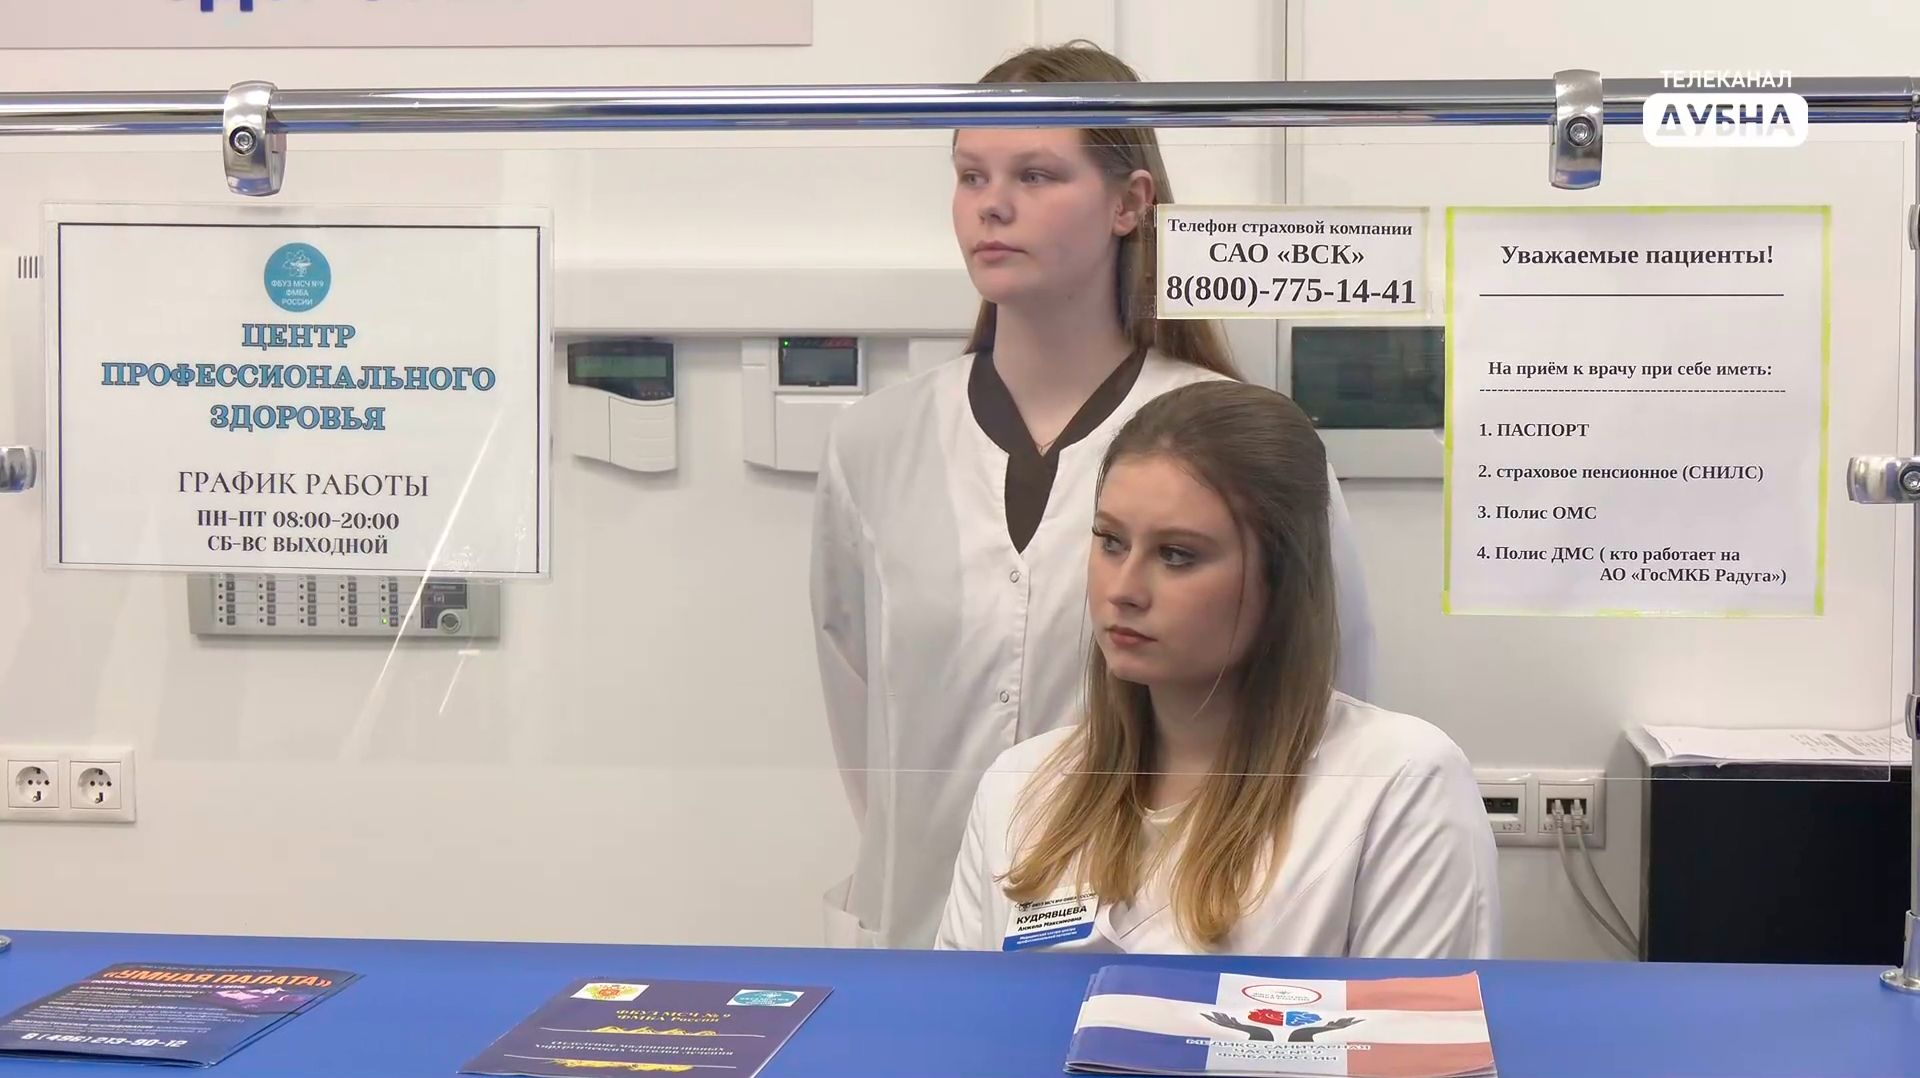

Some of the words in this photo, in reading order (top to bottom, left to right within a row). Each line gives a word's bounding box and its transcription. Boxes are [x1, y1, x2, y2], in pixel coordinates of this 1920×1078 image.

[1167, 218, 1237, 236] Телефон
[1241, 220, 1325, 237] страховой
[1329, 223, 1413, 236] компании
[1209, 242, 1269, 264] САО
[1277, 243, 1365, 265] «ВСК»
[1500, 245, 1639, 267] Уважаемые
[1645, 245, 1774, 269] пациенты!
[1166, 275, 1417, 308] 8(800)-775-14-41
[241, 323, 357, 352] ЦЕНТР
[101, 361, 497, 392] ПРОФЕССИОНАЛЬНОГО
[1487, 361, 1512, 375] На
[1516, 361, 1569, 380] приём
[1573, 365, 1585, 376] к
[1588, 364, 1637, 380] врачу
[1641, 365, 1673, 380] при
[1677, 360, 1712, 376] себе
[1716, 365, 1773, 376] иметь:
[209, 404, 386, 433] ЗДОРОВЬЯ
[1479, 423, 1493, 437] 1.
[1496, 423, 1590, 437] ПАСПОРТ
[178, 470, 298, 495] ГРАФИК
[305, 473, 429, 497] РАБОТЫ
[1478, 464, 1492, 478] 2.
[1496, 466, 1578, 482] страховое
[1581, 466, 1678, 479] пенсионное
[1682, 465, 1764, 483] (СНИЛС)
[196, 509, 267, 528] ПН-ПТ
[272, 510, 400, 531] 08:00-20:00
[1477, 505, 1491, 519] 3.
[1495, 505, 1548, 520] Полис
[1552, 506, 1598, 520] ОМС
[207, 535, 267, 552] СБ-ВС
[273, 535, 389, 556] ВЫХОДНОЙ
[1476, 545, 1491, 560] 4.
[1495, 546, 1549, 561] Полис
[1551, 546, 1595, 564] ДМС
[1609, 550, 1638, 561] кто
[1642, 546, 1717, 565] работает
[1720, 550, 1741, 562] на
[1599, 567, 1626, 582] АО
[1631, 567, 1710, 582] «ГосМКБ
[1714, 567, 1787, 586] Радуга»)
[1016, 905, 1087, 924] КУДРЯВЦЕВА
[1018, 923, 1043, 931] Анжела
[1043, 917, 1082, 927] Максимовна
[103, 969, 214, 983] «УМНАЯ
[212, 973, 333, 988] ПАЛАТА»
